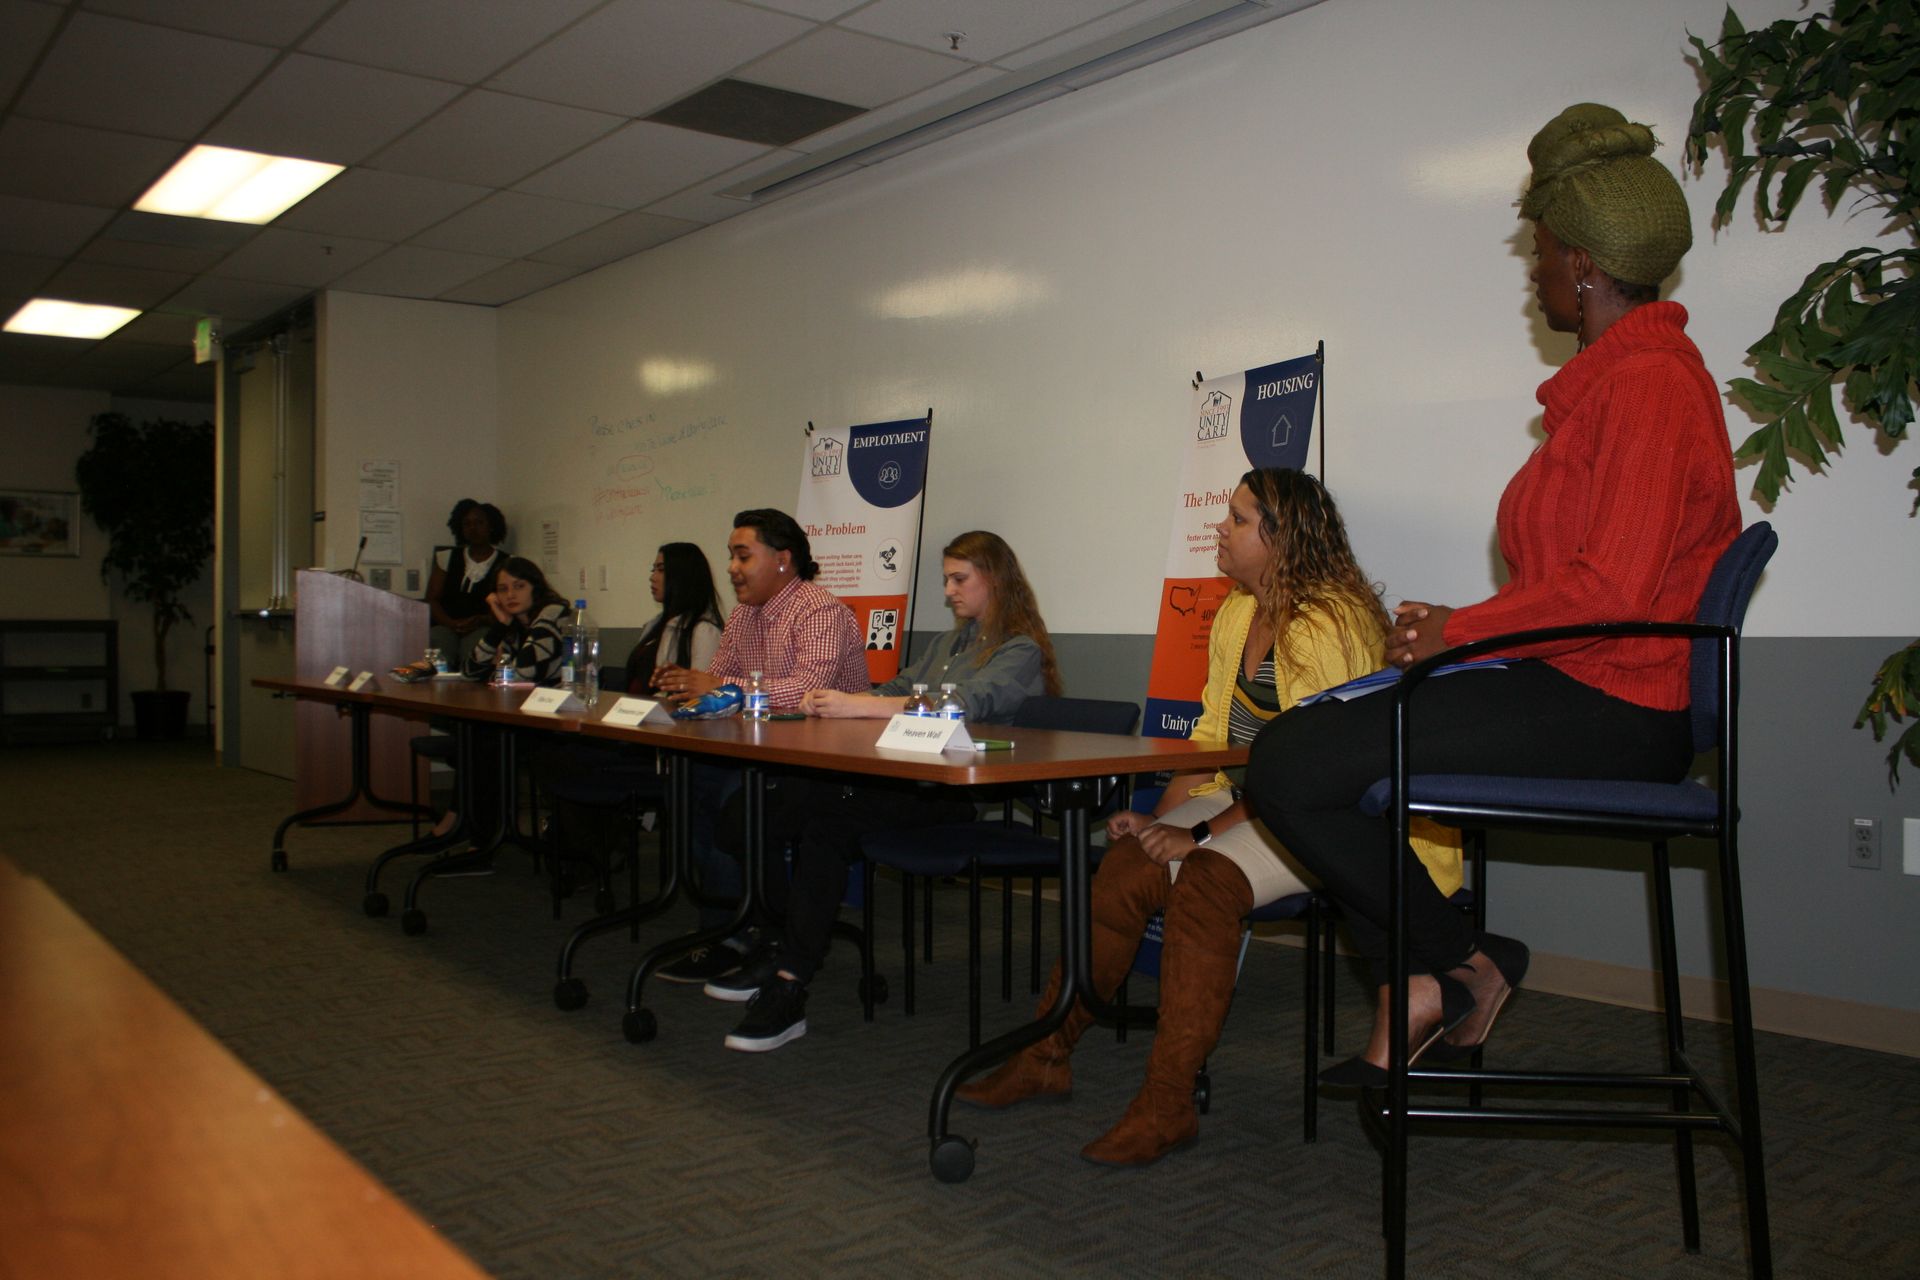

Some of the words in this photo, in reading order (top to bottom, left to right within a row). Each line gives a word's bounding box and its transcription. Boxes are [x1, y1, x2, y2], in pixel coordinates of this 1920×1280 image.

[1257, 372, 1314, 400] HOUSING
[1200, 413, 1227, 429] UNITY
[853, 431, 926, 449] EMPLOYMENT
[1198, 425, 1225, 440] CARE
[813, 455, 840, 467] UNITY
[812, 465, 838, 476] CARE
[1184, 493, 1203, 507] The
[1205, 488, 1232, 506] Probl
[806, 524, 823, 536] The
[826, 522, 866, 536] Problem
[1189, 544, 1217, 554] unprepared
[1162, 714, 1190, 736] Unity
[902, 728, 926, 738] Heaven
